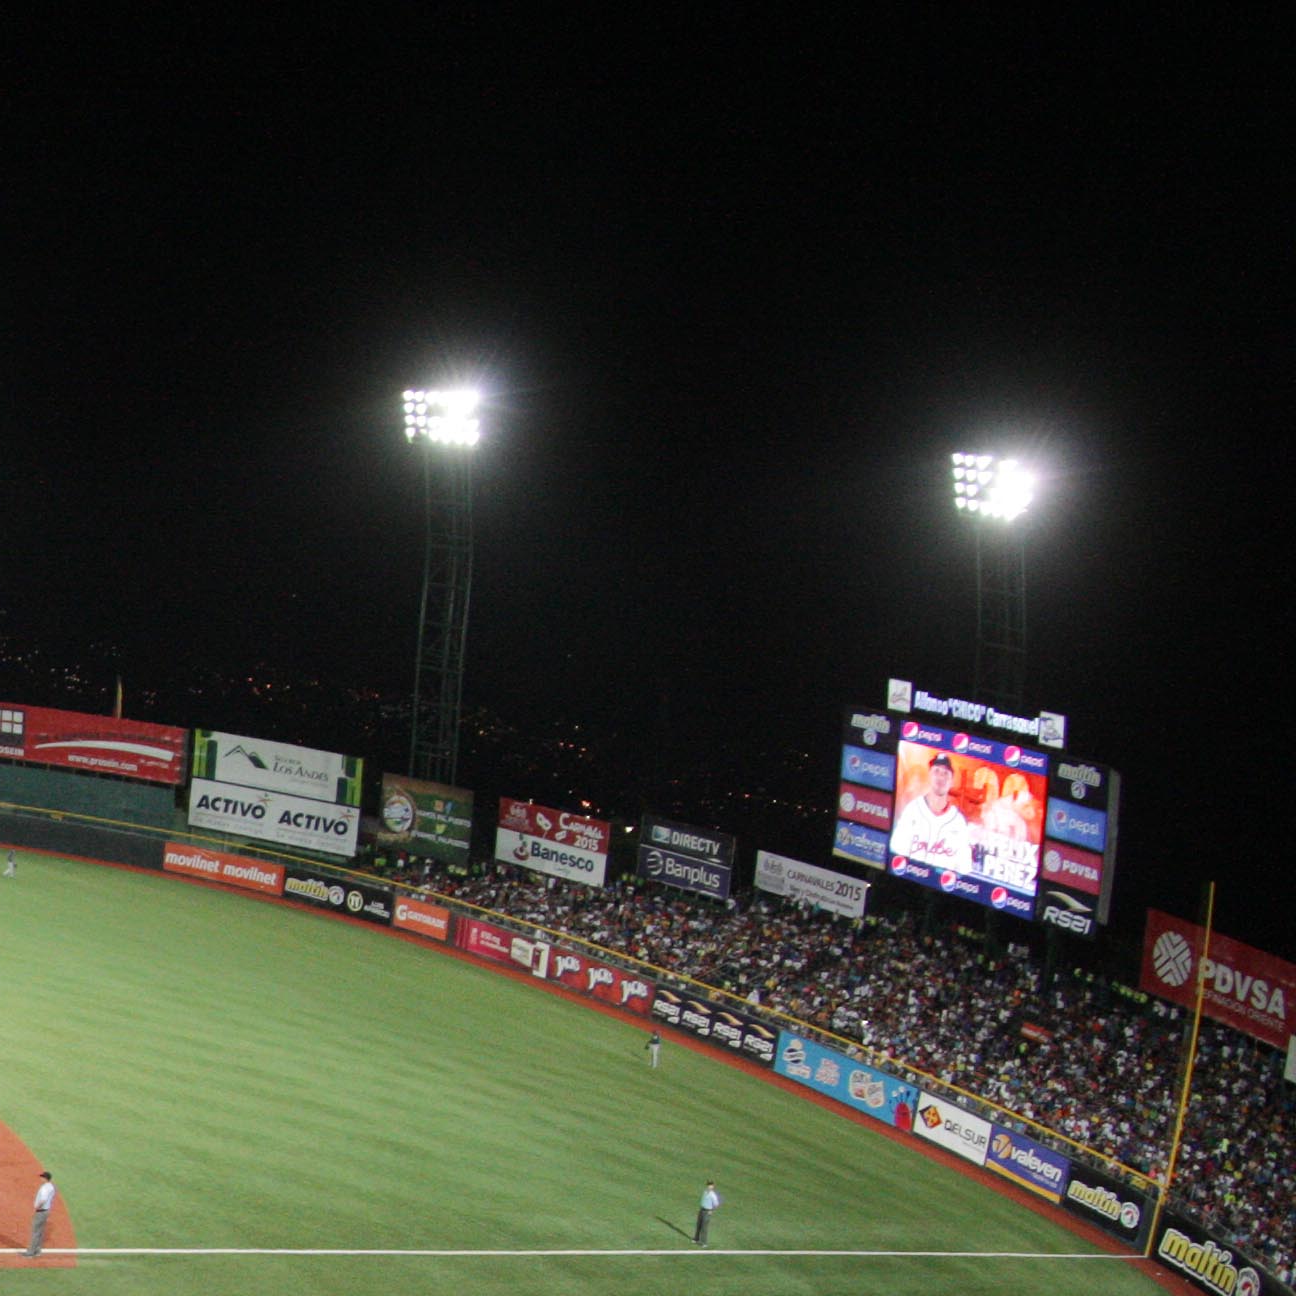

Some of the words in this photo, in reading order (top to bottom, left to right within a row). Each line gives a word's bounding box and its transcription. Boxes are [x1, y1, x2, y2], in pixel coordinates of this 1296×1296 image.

[197, 794, 265, 819] ACTIVO
[278, 810, 348, 835] ACTIVO
[856, 800, 888, 819] PDVSA
[1069, 817, 1100, 836] pepsi
[531, 841, 594, 873] Banesco
[574, 834, 600, 852] 2015
[671, 831, 720, 855] DIRECTV
[165, 850, 220, 873] movilnet
[223, 862, 277, 887] movilnet
[665, 857, 720, 889] Banplus
[1062, 860, 1099, 881] PDVSA
[835, 880, 862, 901] 2015
[1043, 905, 1091, 935] RS21
[1198, 955, 1285, 1021] PDVSA
[944, 1117, 987, 1149] DELSUR
[1011, 1142, 1062, 1182] valeven
